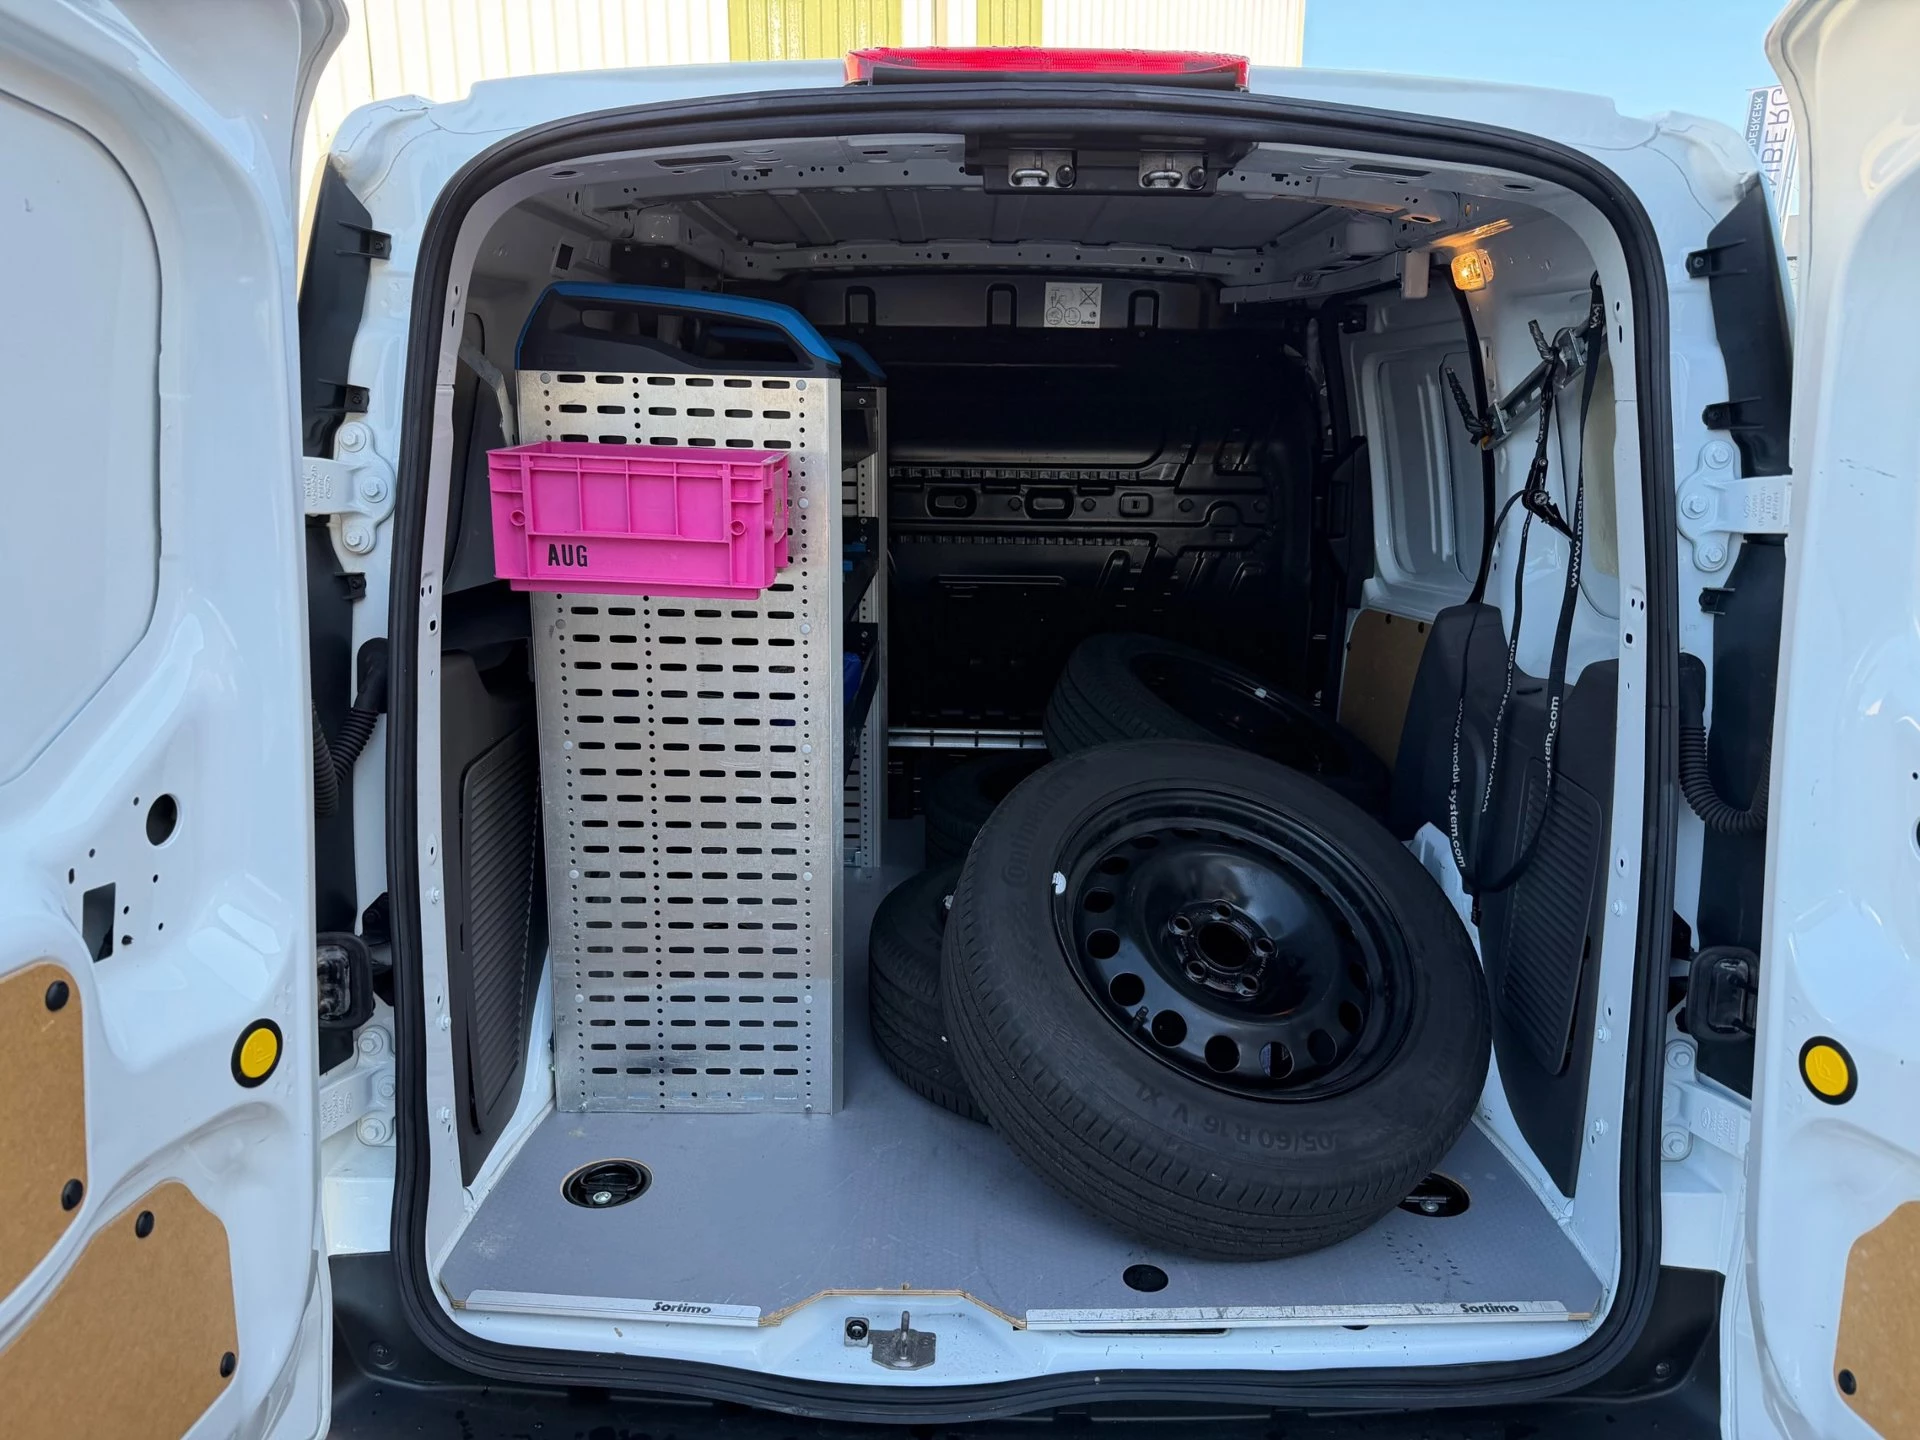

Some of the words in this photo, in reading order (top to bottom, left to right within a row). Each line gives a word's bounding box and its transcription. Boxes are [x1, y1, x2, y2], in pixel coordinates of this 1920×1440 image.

[1570, 486, 1584, 589] www.modul
[548, 543, 588, 567] AUG
[1545, 696, 1560, 790] system.com
[1448, 699, 1466, 868] www.modul-system.com
[1203, 1114, 1229, 1138] 16
[1257, 1126, 1342, 1152] 05/60
[652, 1301, 712, 1314] Sortimo
[1460, 1302, 1520, 1313] Sortimo
